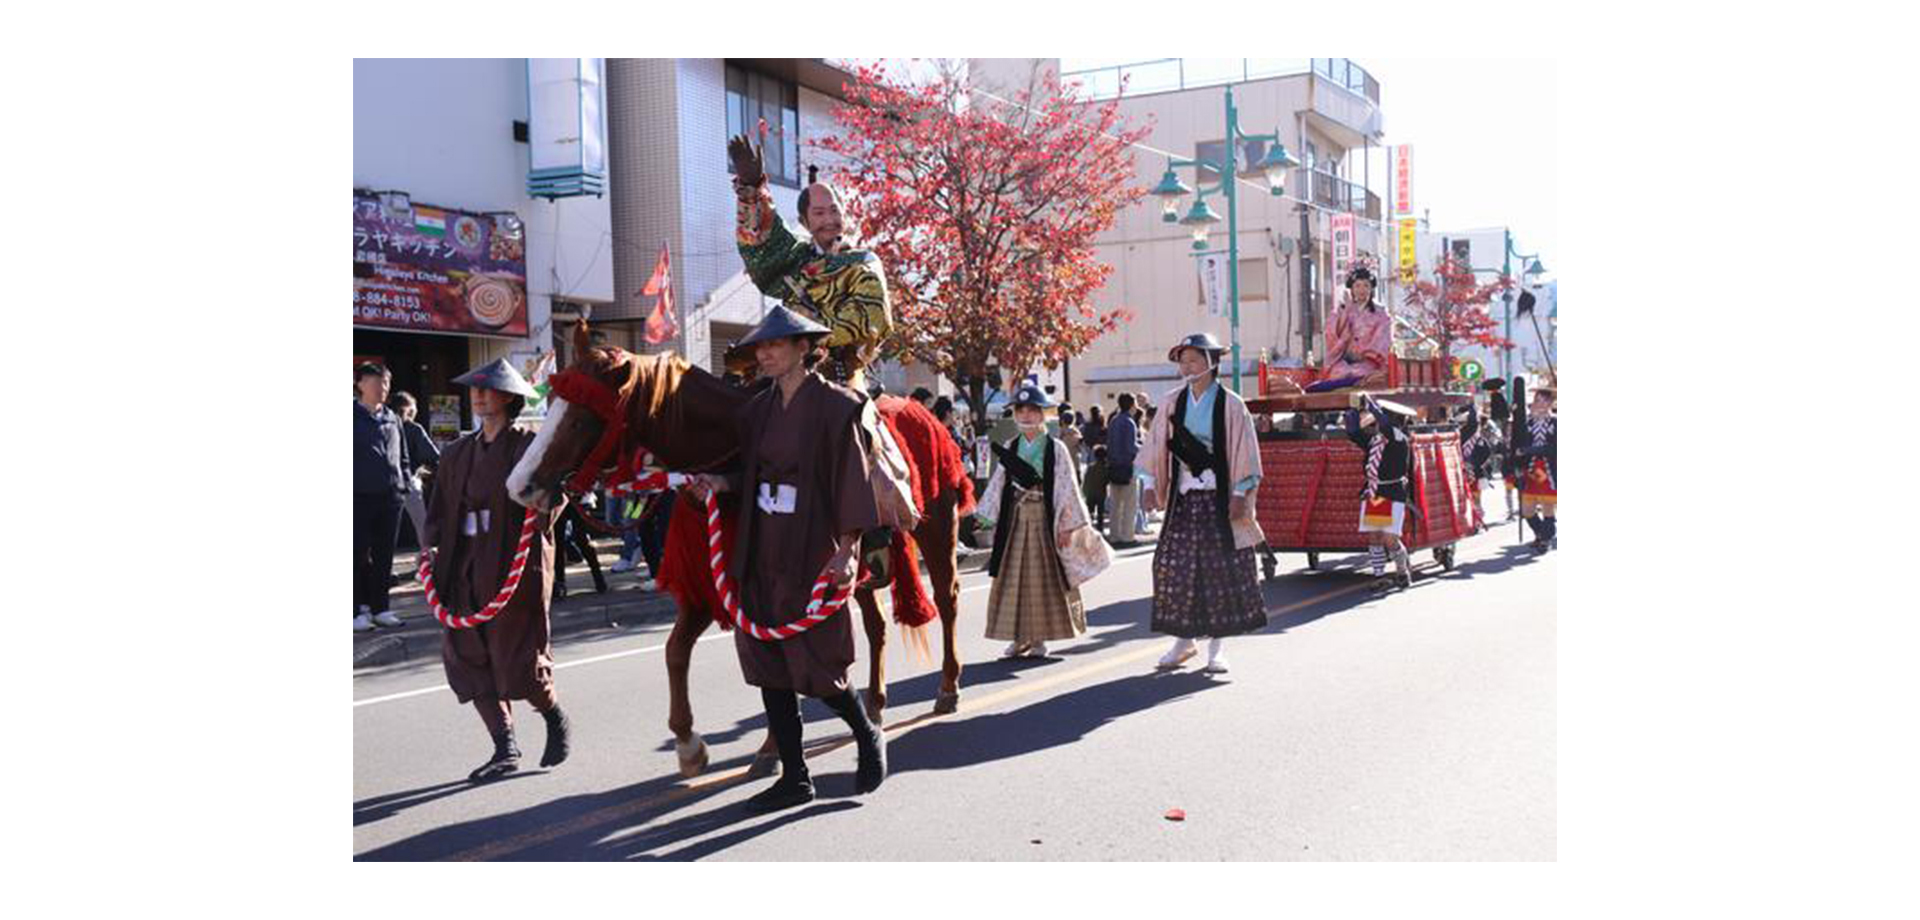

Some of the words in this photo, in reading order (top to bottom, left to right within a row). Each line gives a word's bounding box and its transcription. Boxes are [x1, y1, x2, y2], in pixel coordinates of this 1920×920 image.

[384, 308, 411, 324] Party
[412, 311, 431, 324] OK!
[1465, 362, 1479, 378] P
